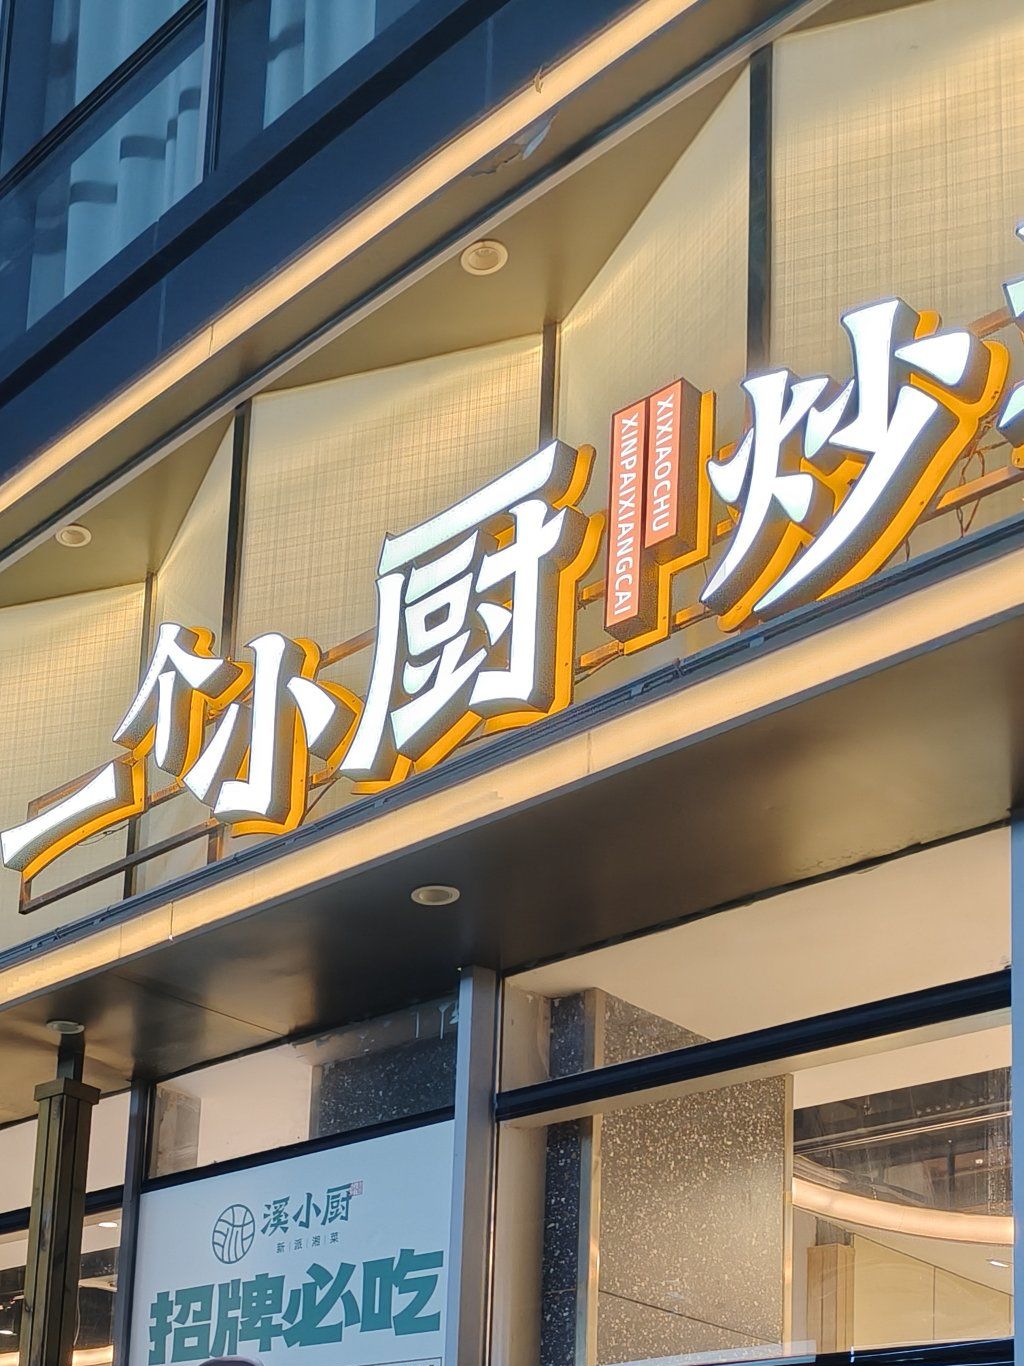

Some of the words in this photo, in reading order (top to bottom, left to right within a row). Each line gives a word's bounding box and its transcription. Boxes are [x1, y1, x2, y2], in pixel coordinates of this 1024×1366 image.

[614, 412, 640, 615] XINPAIXIANGCAI
[653, 392, 674, 533] XIXIAOCHU
[260, 1183, 352, 1236] 溪小厨
[148, 1248, 444, 1366] 招牌必吃
